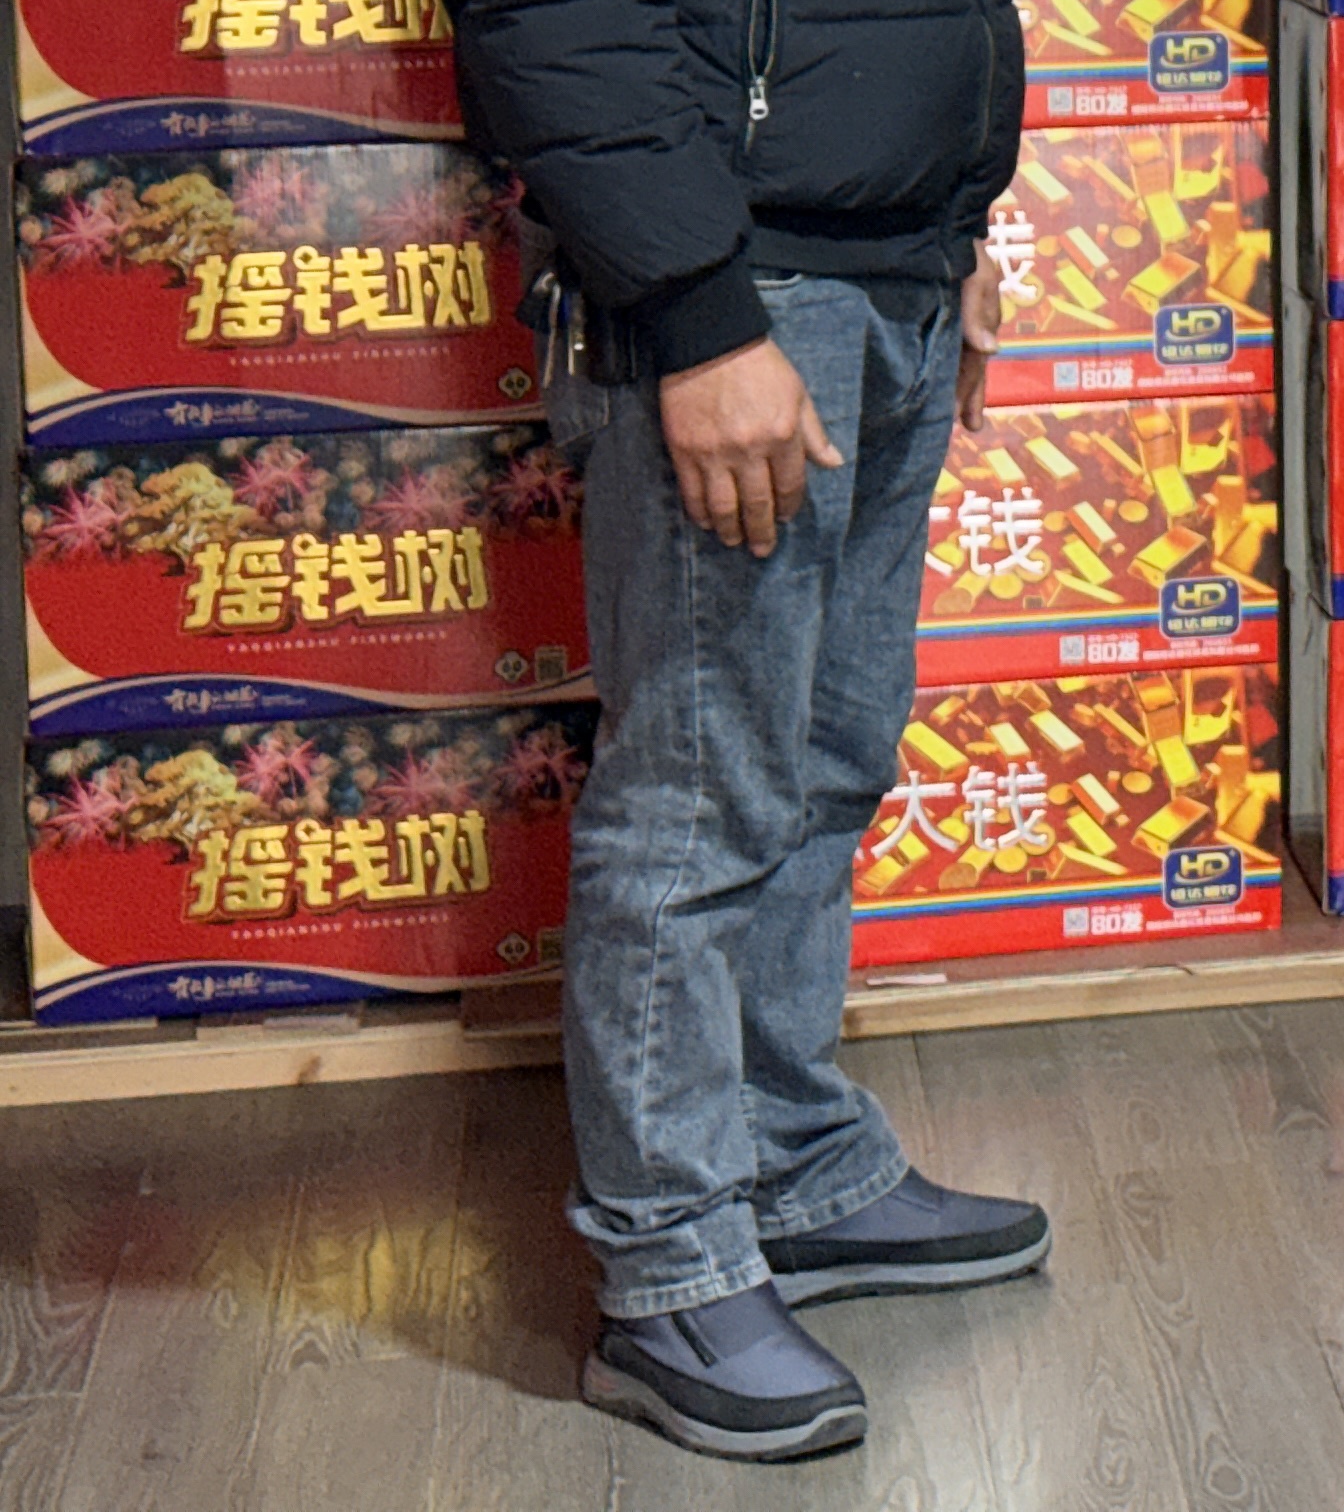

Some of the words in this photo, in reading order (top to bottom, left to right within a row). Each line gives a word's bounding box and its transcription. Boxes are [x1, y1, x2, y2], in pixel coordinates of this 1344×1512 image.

[1158, 37, 1216, 65] HD
[185, 241, 492, 342] 摇钱树
[1171, 309, 1222, 337] HD
[184, 528, 491, 630] 摇钱树
[1176, 582, 1228, 609] HD
[189, 810, 491, 919] 摇钱树
[1180, 852, 1231, 880] HD
